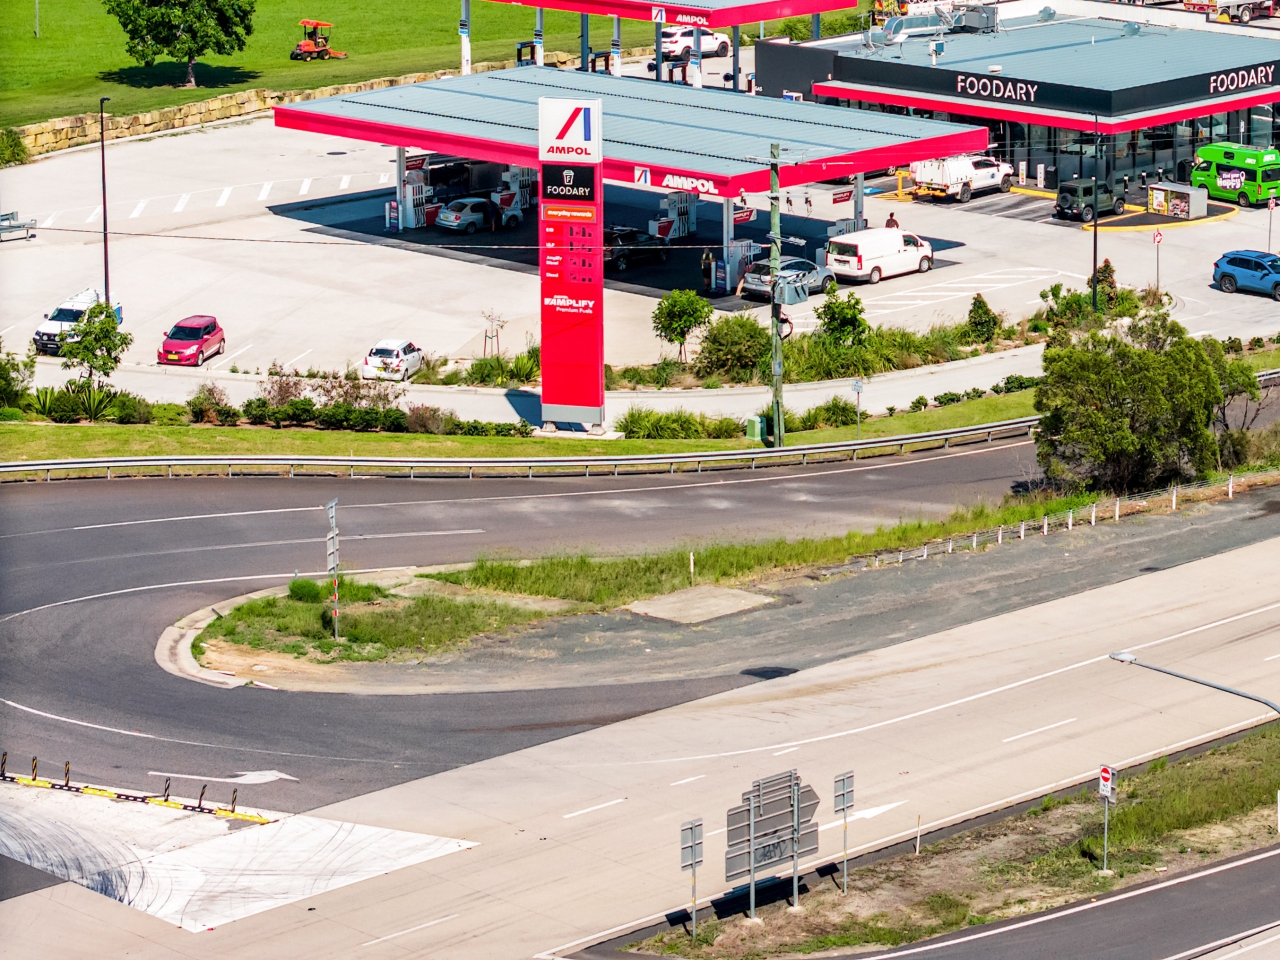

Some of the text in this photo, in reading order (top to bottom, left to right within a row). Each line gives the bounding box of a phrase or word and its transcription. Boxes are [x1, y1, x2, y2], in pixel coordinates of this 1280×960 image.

[676, 14, 709, 25] AMPOL
[1209, 65, 1275, 93] FOODARY
[957, 75, 1038, 101] FOODARY
[546, 146, 591, 156] AMPOL
[661, 174, 719, 194] AMPOL
[547, 185, 590, 196] FOODARY
[549, 298, 595, 308] AMPLIFY
